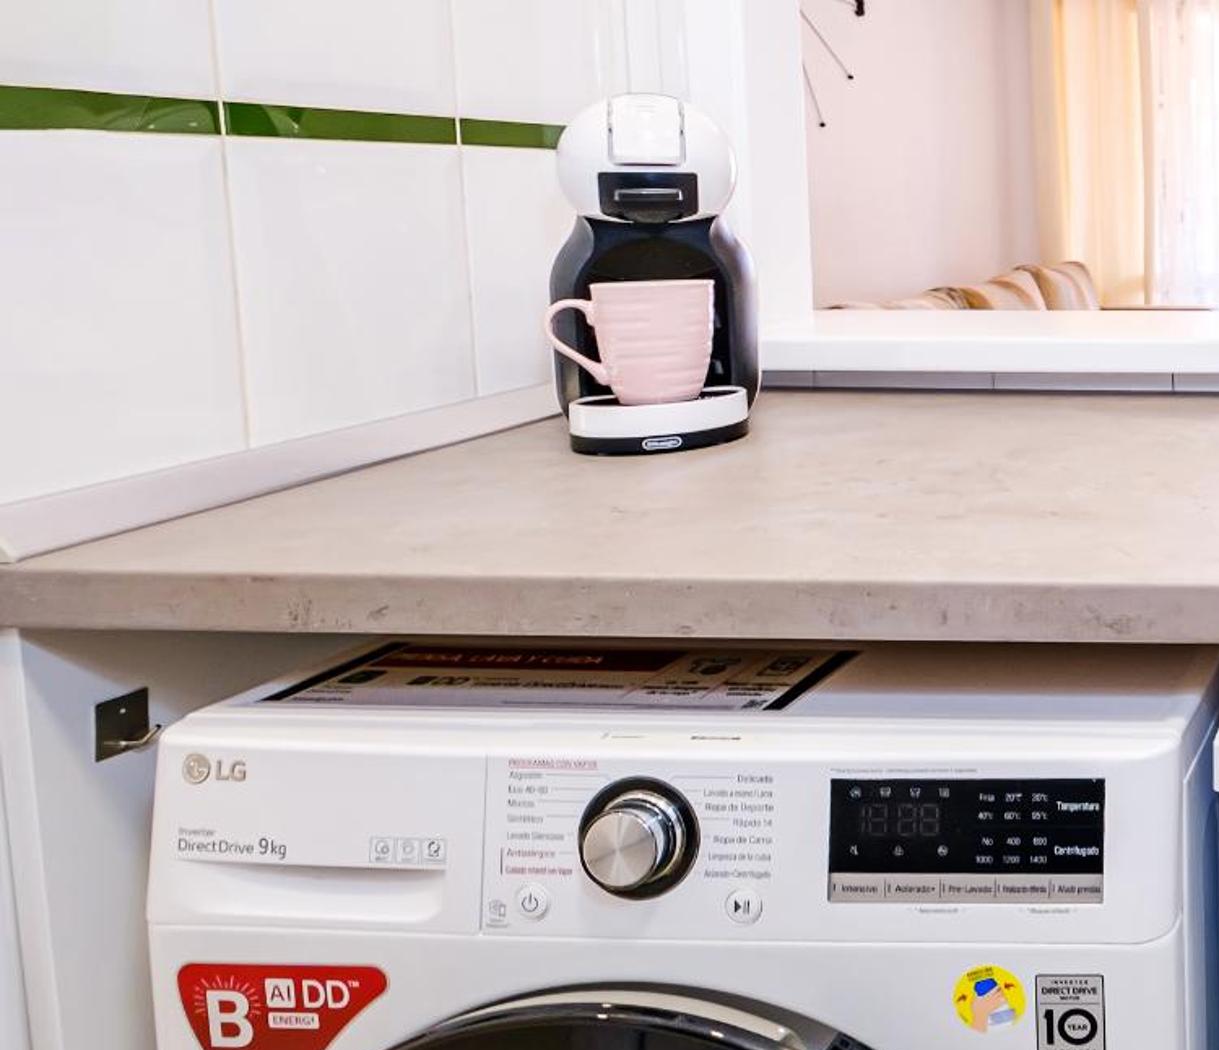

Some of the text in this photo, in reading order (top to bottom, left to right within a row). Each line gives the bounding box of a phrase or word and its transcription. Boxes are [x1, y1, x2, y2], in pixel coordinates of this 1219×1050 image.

[215, 760, 247, 782] LG
[1056, 801, 1100, 813] Temperatura
[1054, 845, 1100, 857] Centrifugado
[1041, 986, 1098, 995] DIRECT DRIVE
[206, 989, 254, 1048] B
[1044, 1008, 1098, 1046] 10
[1067, 1023, 1088, 1031] YEAR
